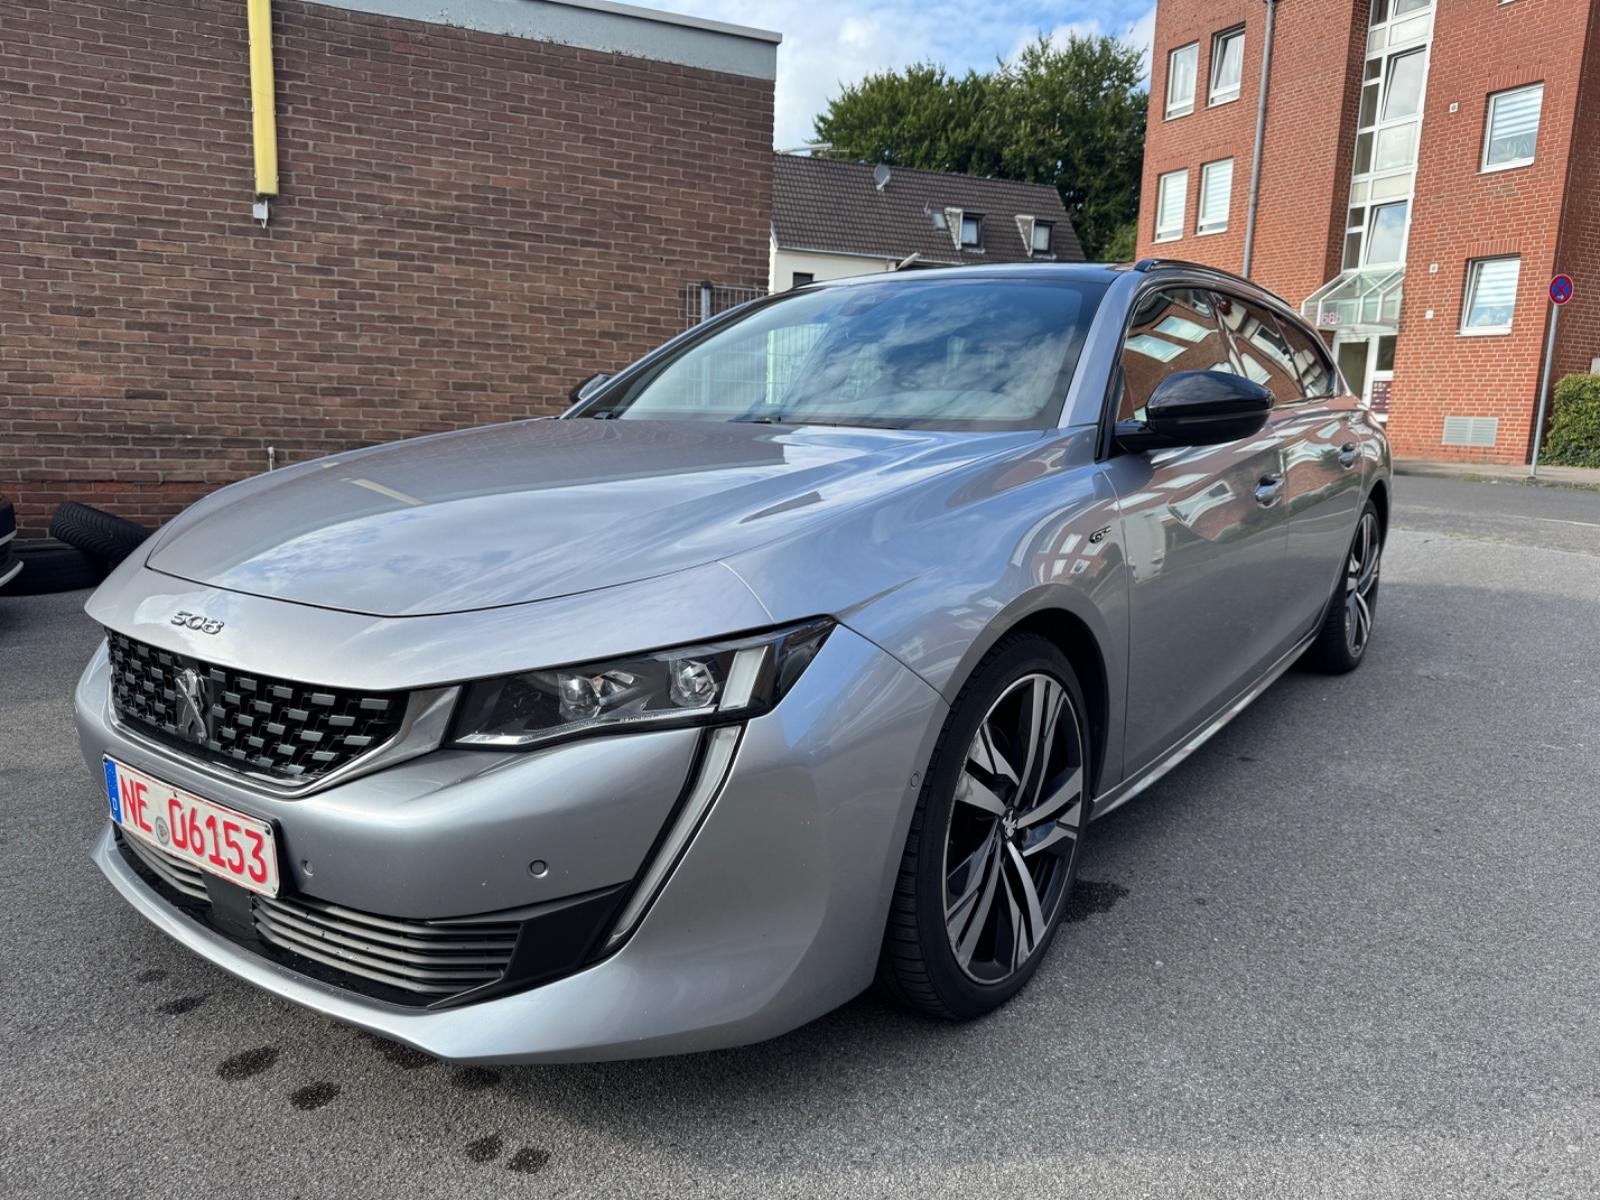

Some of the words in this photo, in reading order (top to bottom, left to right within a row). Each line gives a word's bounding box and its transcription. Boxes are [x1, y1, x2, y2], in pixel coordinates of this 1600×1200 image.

[170, 610, 225, 635] 508
[120, 773, 153, 833] NE
[168, 798, 267, 884] 06153
